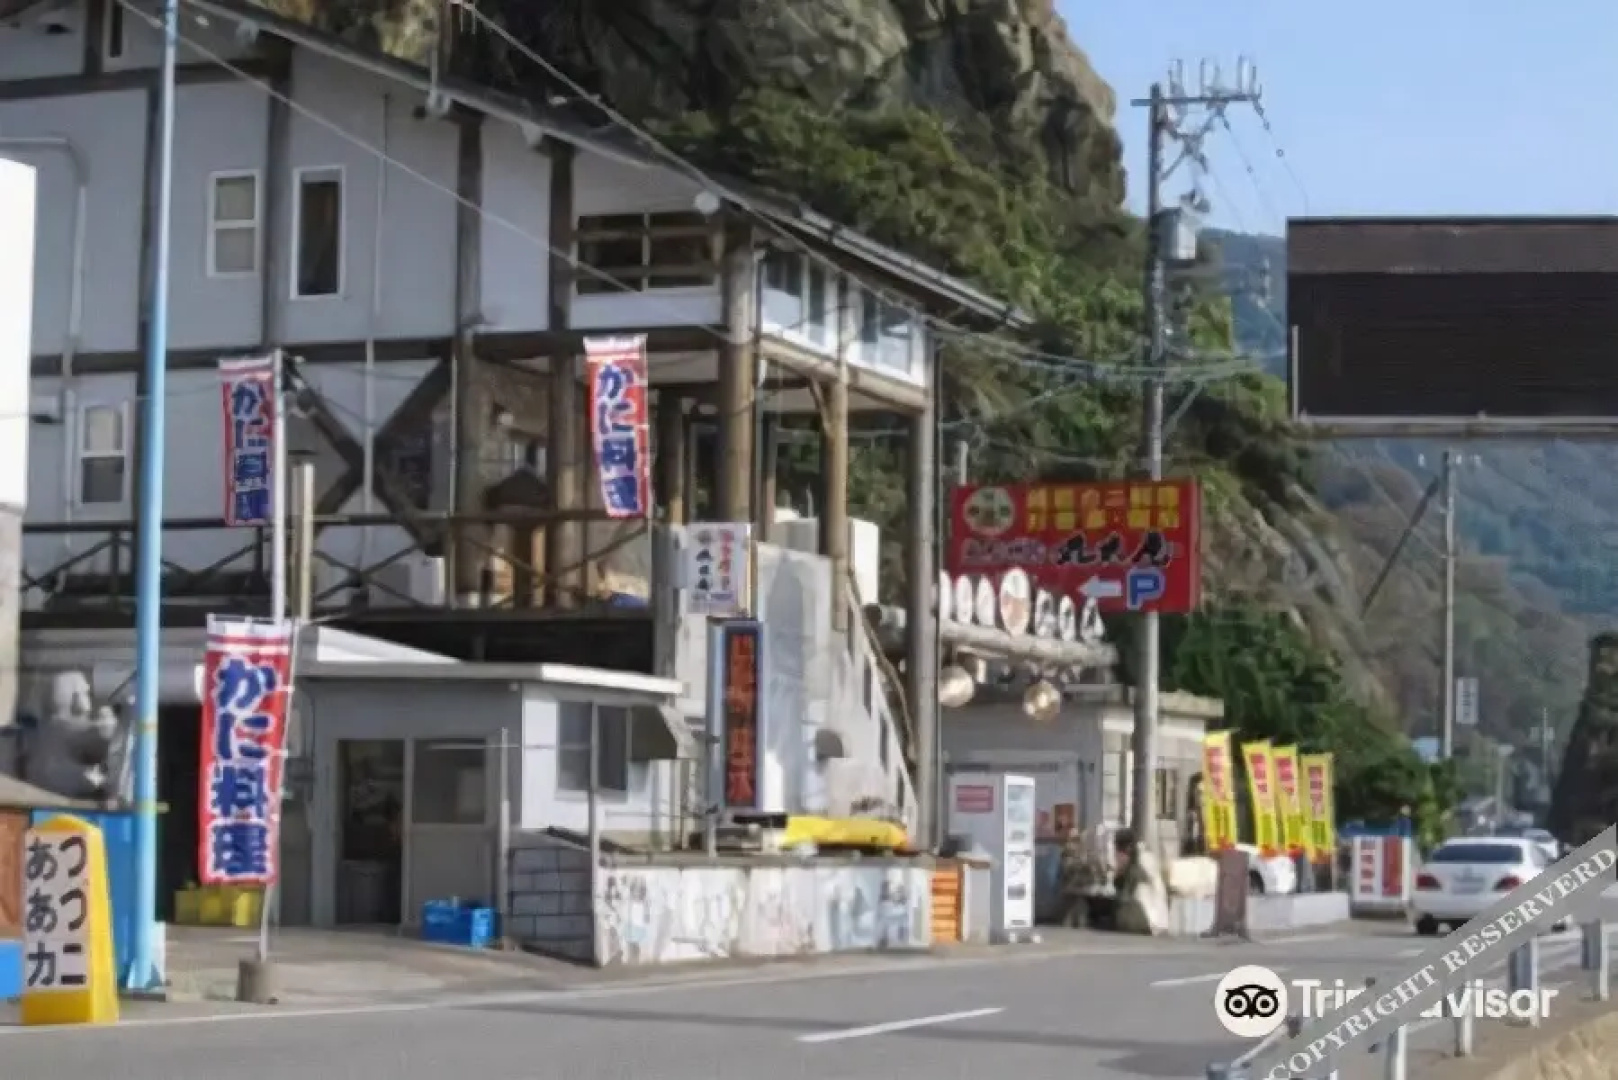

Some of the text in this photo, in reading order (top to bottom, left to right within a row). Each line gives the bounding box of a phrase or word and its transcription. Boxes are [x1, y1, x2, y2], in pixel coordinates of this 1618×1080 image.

[1126, 567, 1165, 610] P
[212, 656, 278, 875] かに料理
